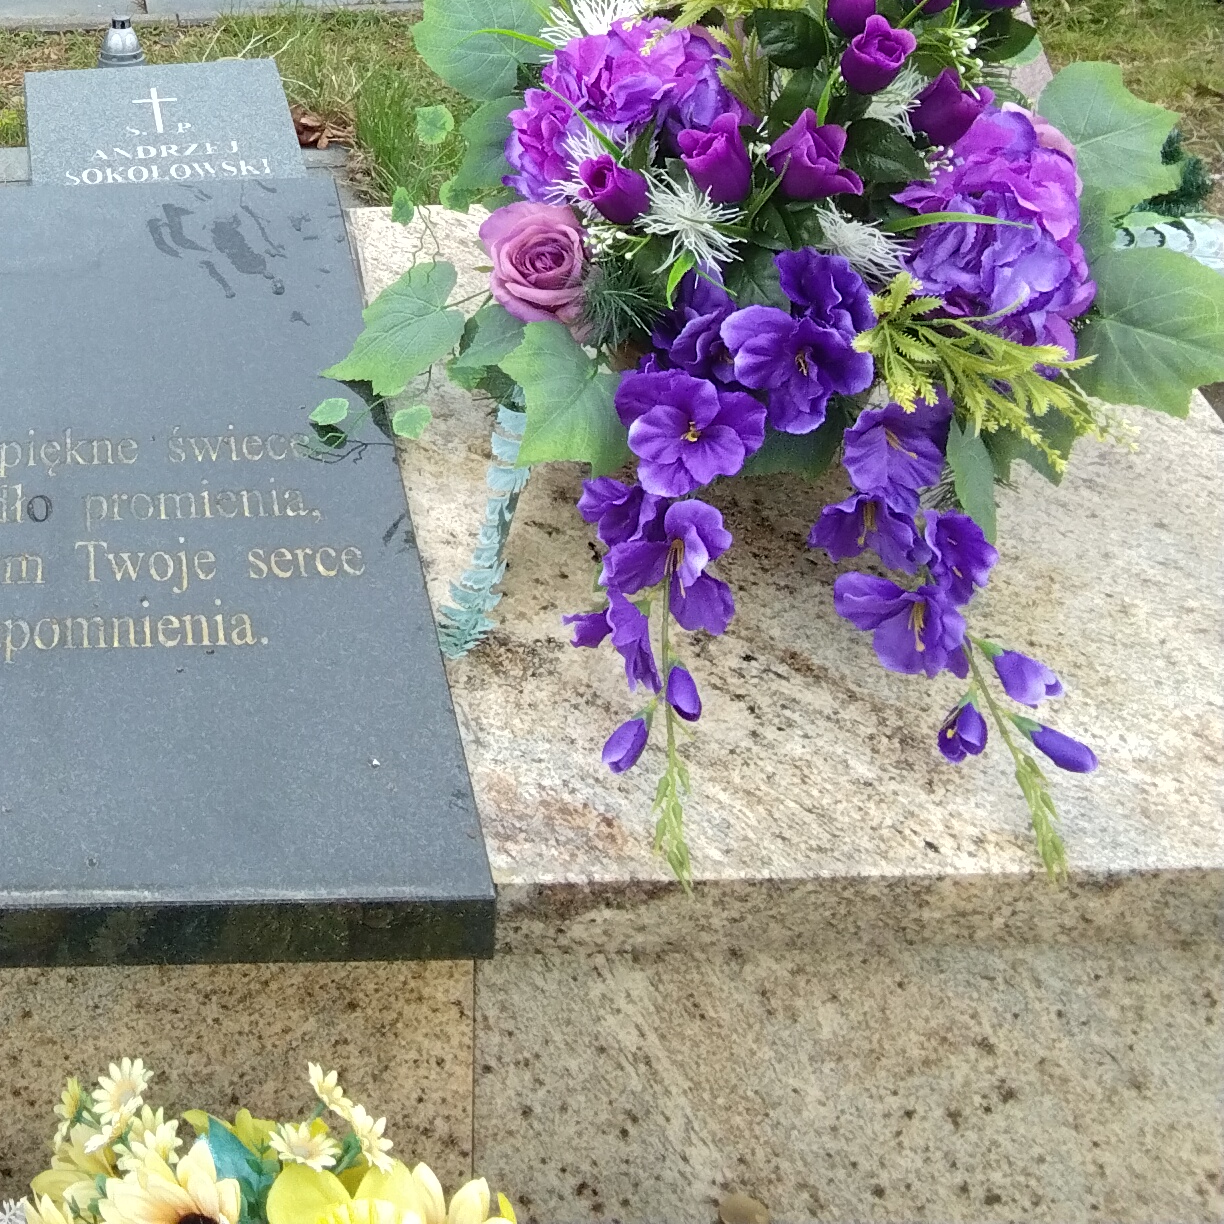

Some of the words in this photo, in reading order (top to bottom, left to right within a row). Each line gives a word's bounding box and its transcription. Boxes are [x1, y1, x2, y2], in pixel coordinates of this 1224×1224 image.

[0, 428, 139, 478] piękne
[81, 477, 323, 533] promienia,
[75, 537, 218, 594] Twoje
[247, 544, 367, 581] serce
